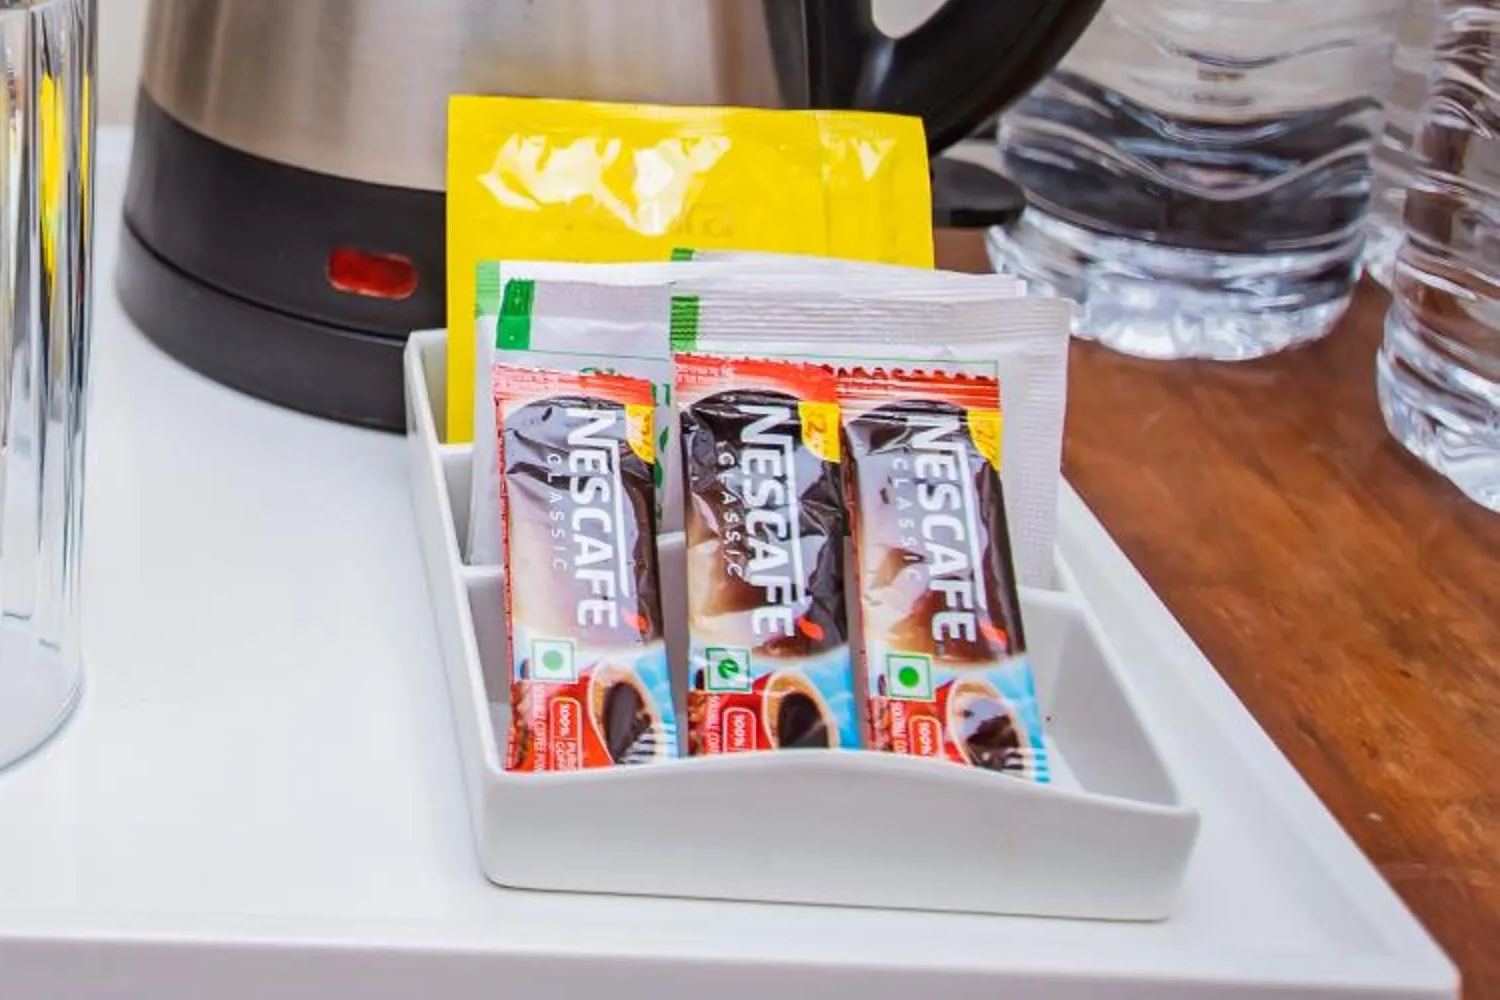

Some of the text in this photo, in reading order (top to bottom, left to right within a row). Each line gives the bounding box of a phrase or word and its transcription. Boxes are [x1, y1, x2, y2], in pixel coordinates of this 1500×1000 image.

[546, 454, 569, 574] CLASSIC
[716, 448, 746, 579] CLASSIC
[891, 457, 924, 586] CLASSIC
[559, 703, 571, 737] 100%
[733, 714, 746, 747] 100%
